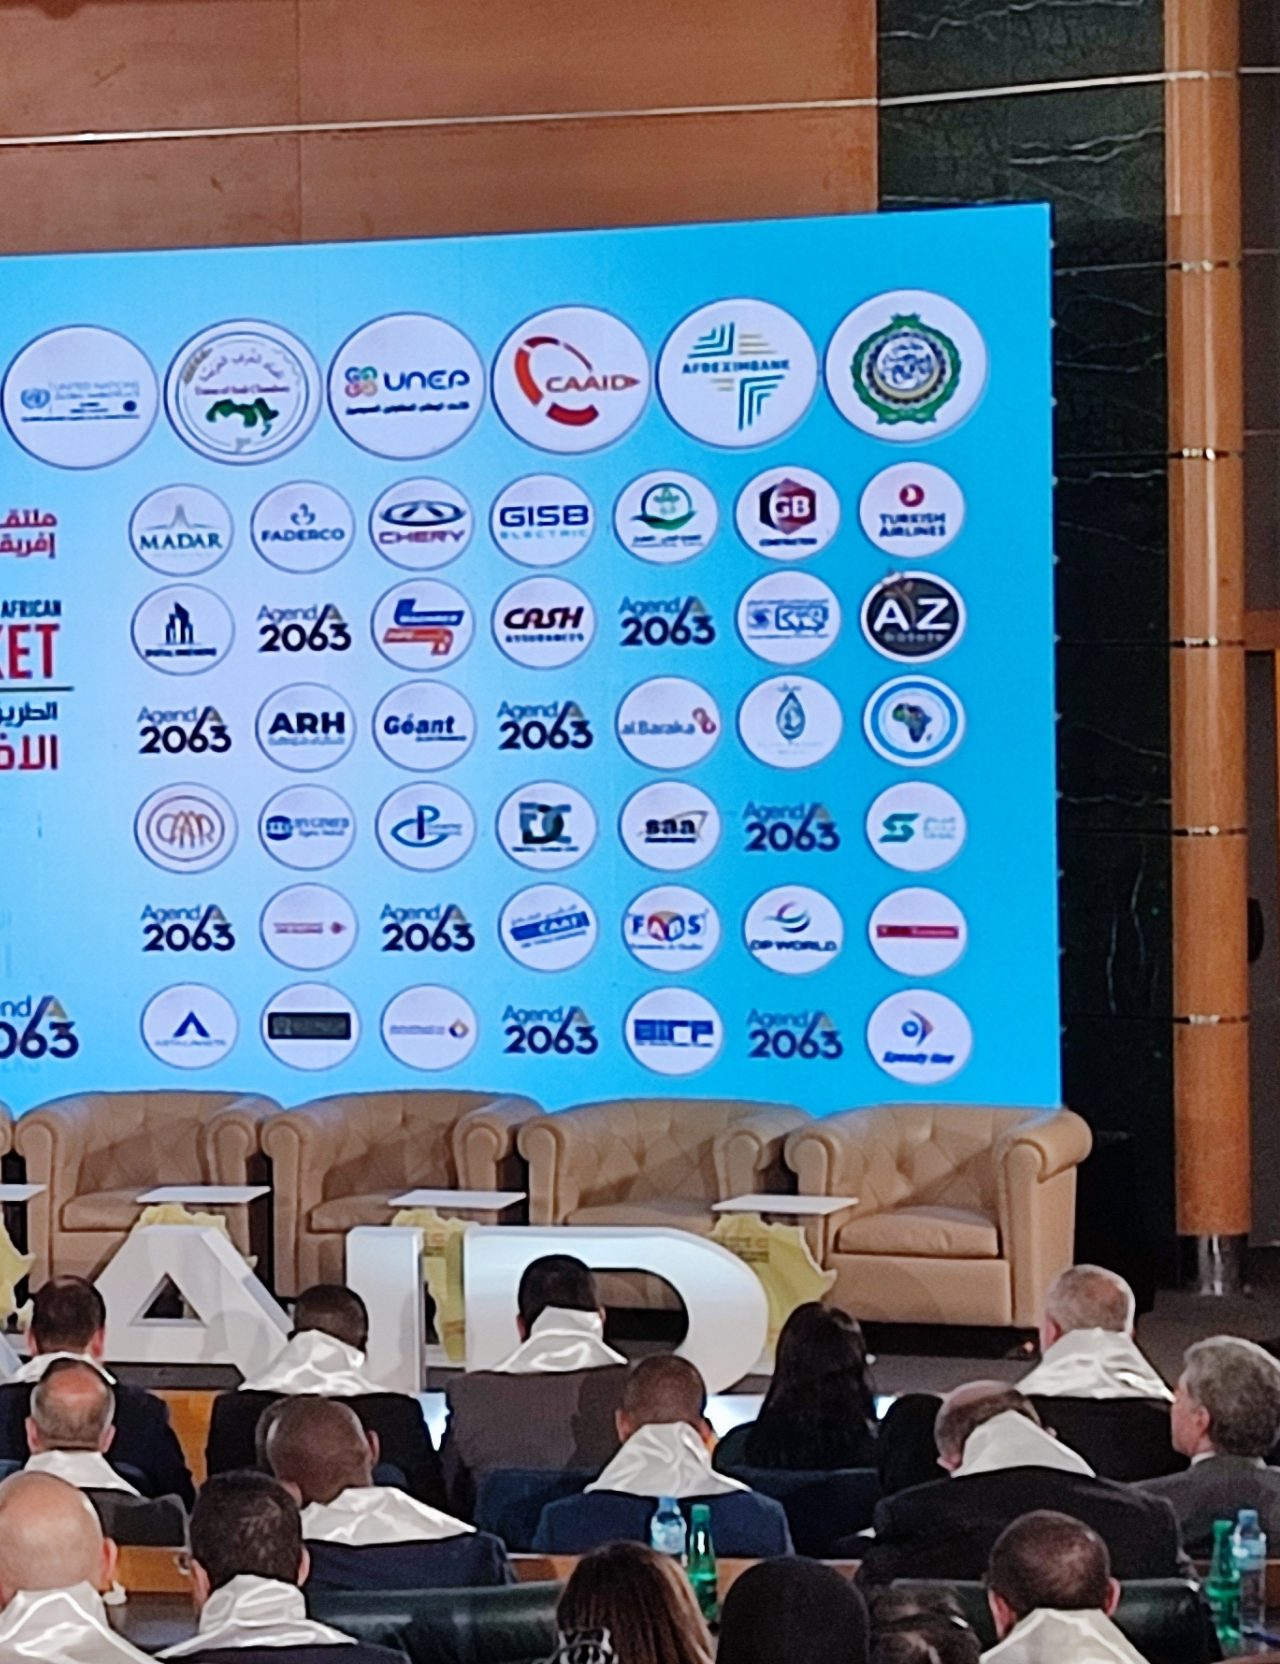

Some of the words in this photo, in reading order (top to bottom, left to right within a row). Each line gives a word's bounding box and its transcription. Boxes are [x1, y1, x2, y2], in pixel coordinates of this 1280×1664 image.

[499, 505, 589, 527] GISB
[140, 533, 223, 550] MADAR
[261, 528, 345, 542] FADERCO
[379, 530, 465, 544] CHERY
[0, 600, 62, 619] AFRICAN
[503, 606, 585, 629] CASH
[873, 598, 952, 632] AZ
[258, 623, 352, 652] 2063
[620, 615, 715, 646] 2063
[268, 711, 345, 735] ARH
[383, 713, 455, 735] Géant
[498, 720, 593, 750] 2063
[139, 725, 232, 754] 2063
[744, 821, 840, 852] 2063
[142, 923, 235, 952] 2063
[381, 923, 475, 952] 2063
[503, 1025, 599, 1055] 2063
[748, 1029, 843, 1060] 2063
